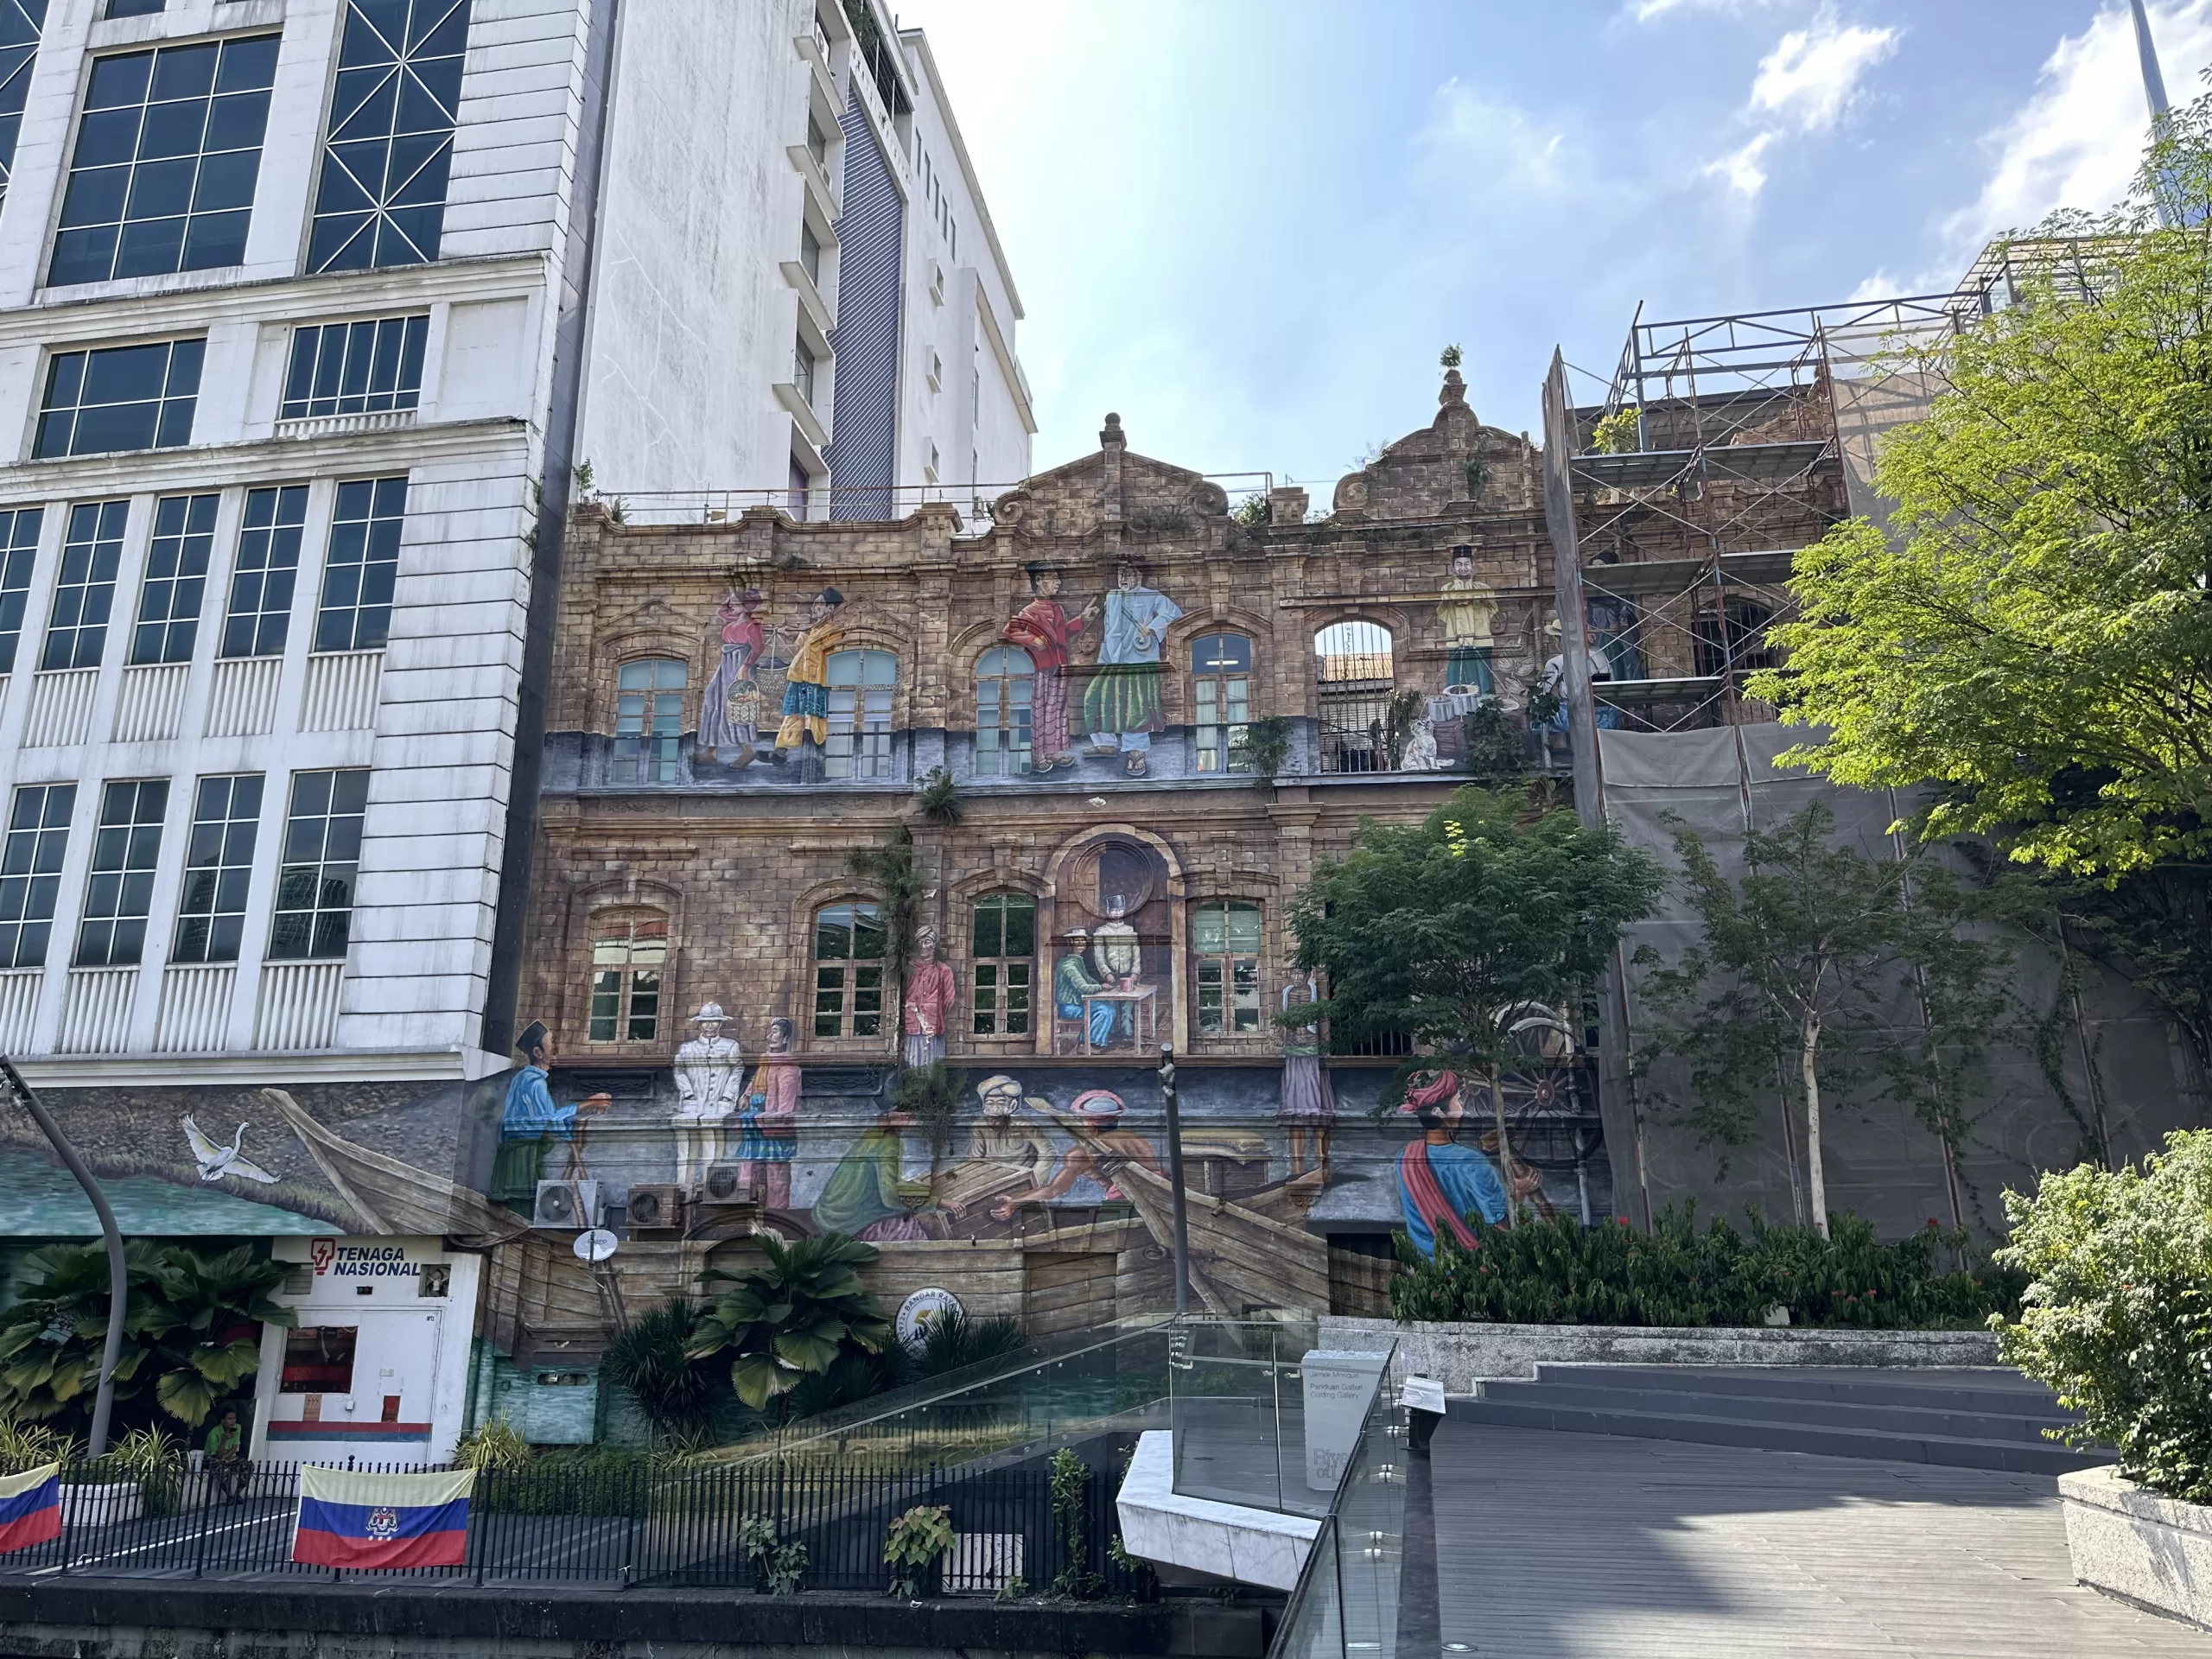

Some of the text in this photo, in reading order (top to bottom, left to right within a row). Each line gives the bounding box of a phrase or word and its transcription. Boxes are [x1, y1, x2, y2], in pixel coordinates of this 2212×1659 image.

[337, 1247, 404, 1261] TENAGA
[334, 1262, 421, 1275] NASIONAL
[905, 1291, 936, 1312] BANDAR
